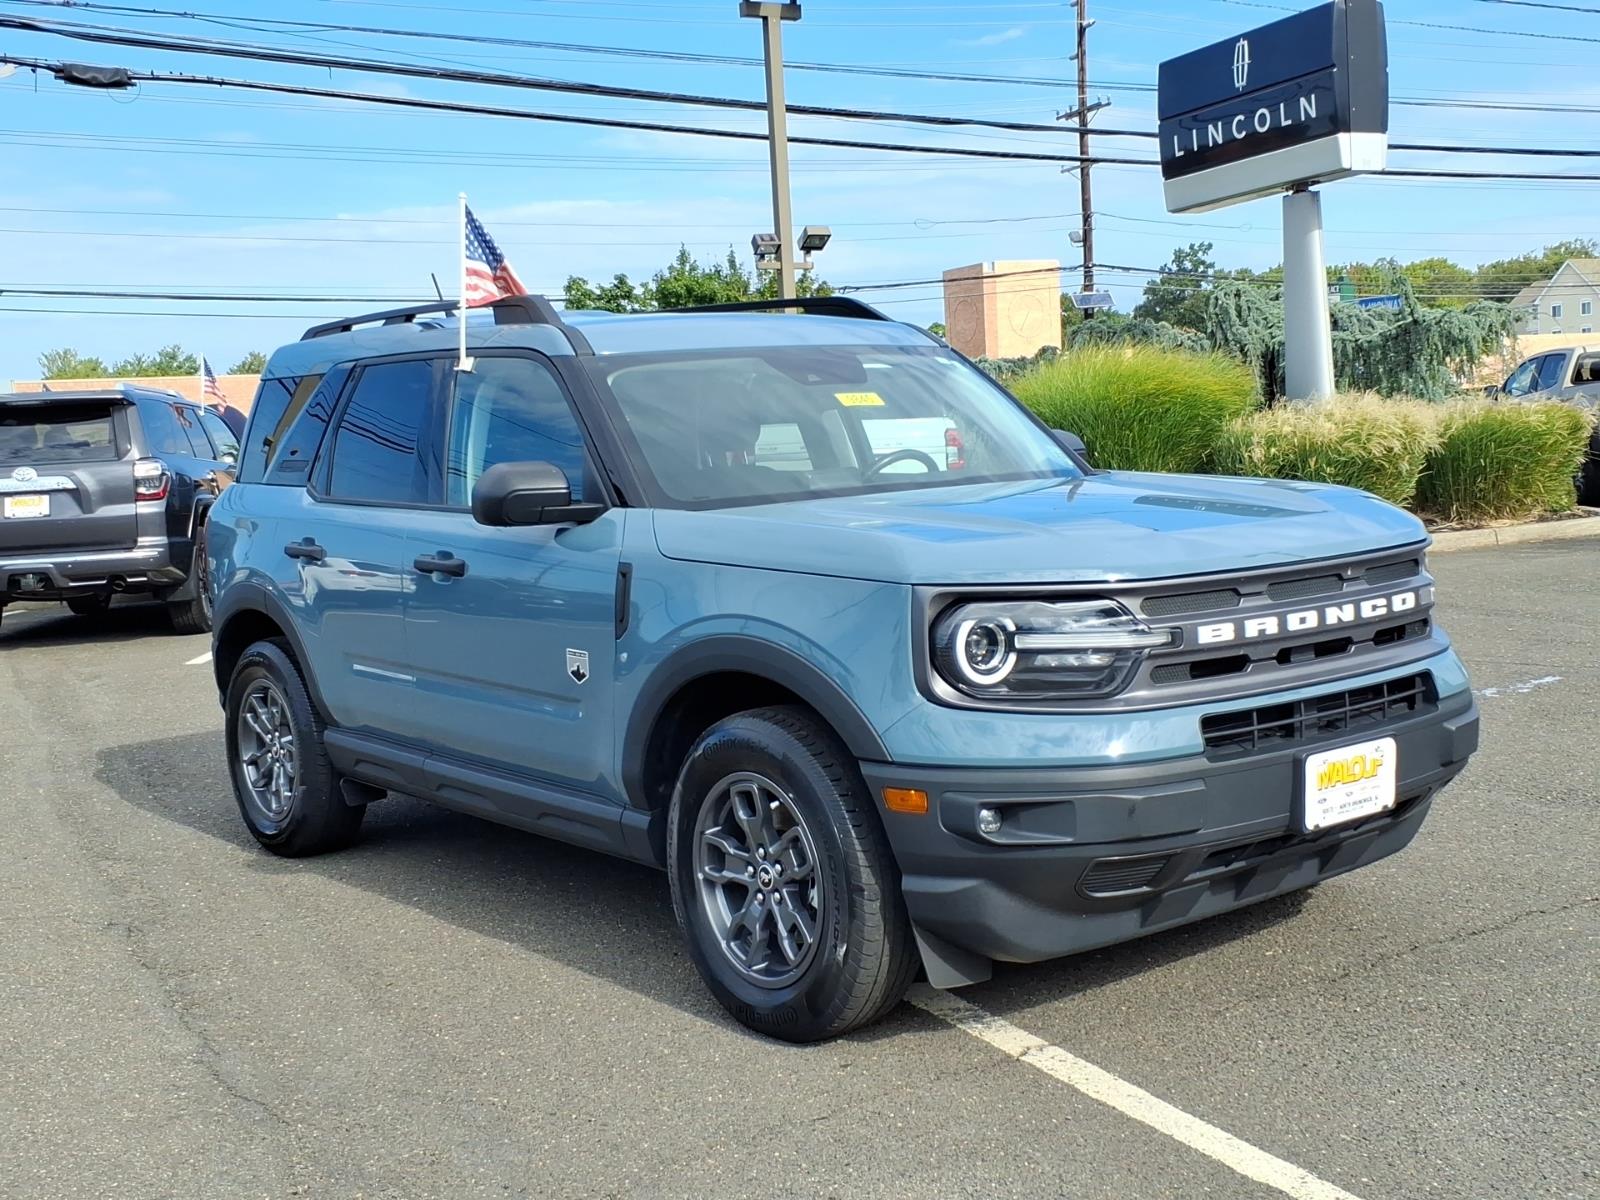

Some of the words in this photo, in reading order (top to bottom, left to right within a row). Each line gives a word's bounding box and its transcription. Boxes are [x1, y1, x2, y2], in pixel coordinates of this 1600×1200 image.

[1173, 93, 1318, 158] LINCOLN
[1197, 591, 1416, 645] BRONCO
[1316, 754, 1384, 791] MALOUF
